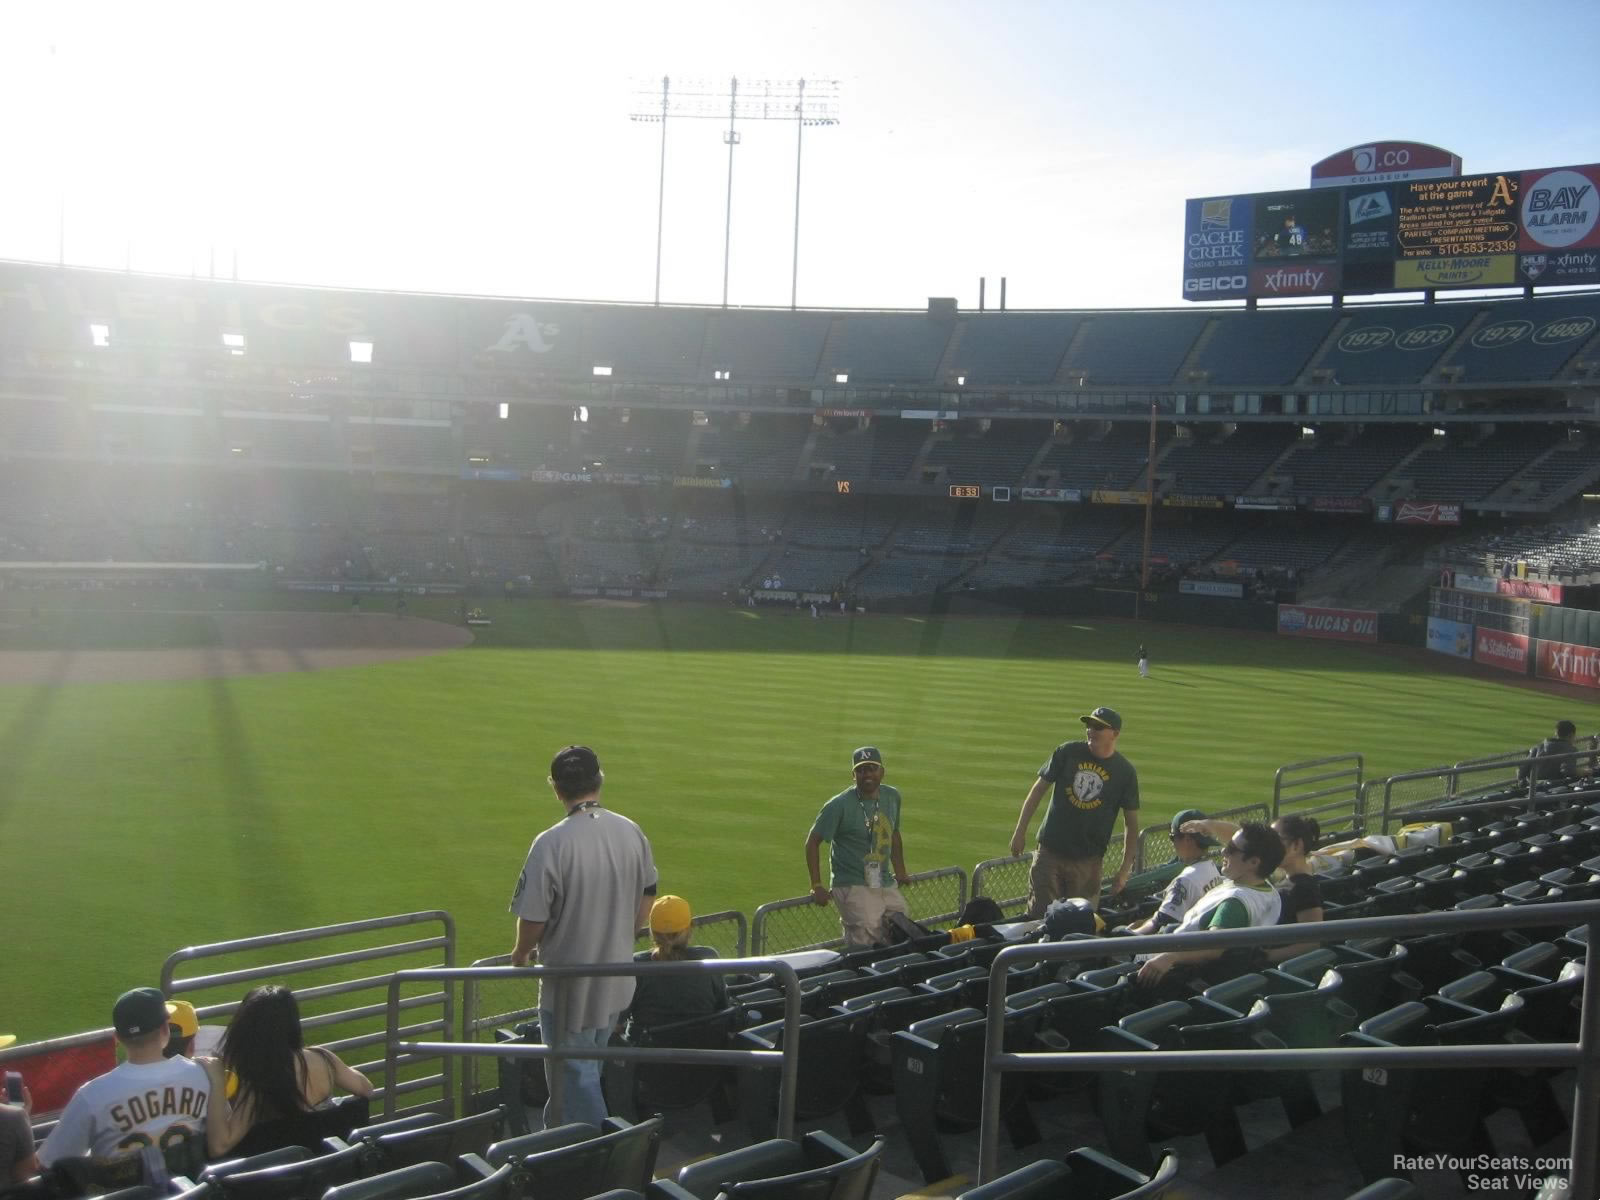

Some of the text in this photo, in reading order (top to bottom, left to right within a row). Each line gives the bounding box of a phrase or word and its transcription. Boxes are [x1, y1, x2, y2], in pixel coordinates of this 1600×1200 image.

[1352, 173, 1409, 183] COLISEUM
[1410, 178, 1488, 192] Have your event
[1429, 191, 1444, 200] the
[1447, 190, 1473, 200] game
[1529, 185, 1592, 212] BAY
[1527, 211, 1588, 227] ALARM
[1189, 231, 1244, 246] CACHE
[1404, 230, 1432, 238] PARTIES
[1438, 227, 1473, 236] COMPANY
[1474, 225, 1509, 233] MEETINGS
[1430, 235, 1486, 244] PRESENTATIONS
[1189, 245, 1243, 260] CREEK
[1557, 253, 1597, 267] xfinity
[1416, 257, 1491, 272] KELLY-MOORE
[1185, 275, 1247, 292] GEICO
[1265, 269, 1325, 292] xfinity
[1438, 271, 1468, 281] PAINTS
[1406, 329, 1448, 344] 1973
[1481, 327, 1527, 341] 1974
[1541, 322, 1591, 338] 1989
[1345, 331, 1386, 346] 1972
[837, 481, 850, 493] VS
[1306, 615, 1350, 632] LUCAS
[1353, 619, 1374, 634] OIL
[1078, 761, 1110, 781] OAKLAND
[1367, 1069, 1383, 1083] 32
[110, 1086, 207, 1132] SOGARD
